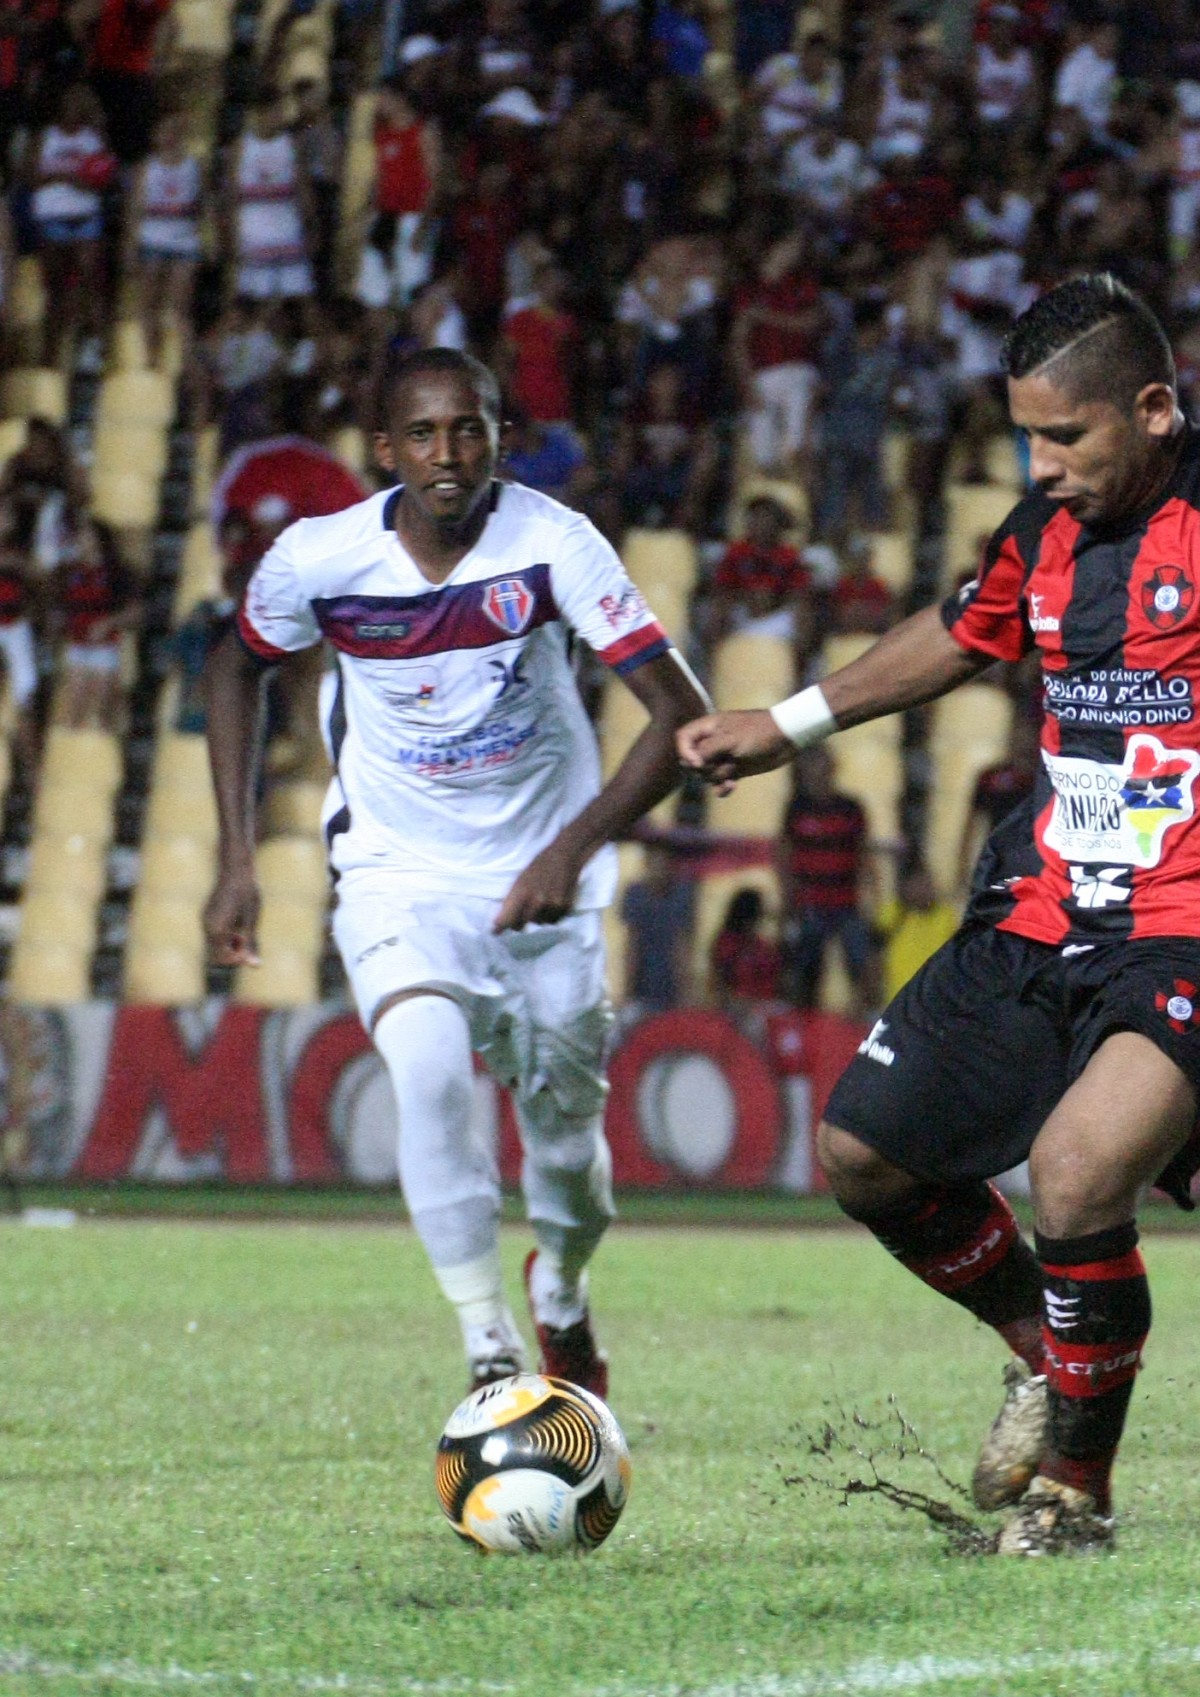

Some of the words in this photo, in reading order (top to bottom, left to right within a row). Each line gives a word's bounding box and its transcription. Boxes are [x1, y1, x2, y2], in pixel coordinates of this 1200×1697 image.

[1090, 670, 1107, 682] DO
[1115, 677, 1189, 704] BELLO
[1146, 706, 1192, 723] DINO
[1096, 774, 1120, 792] DO
